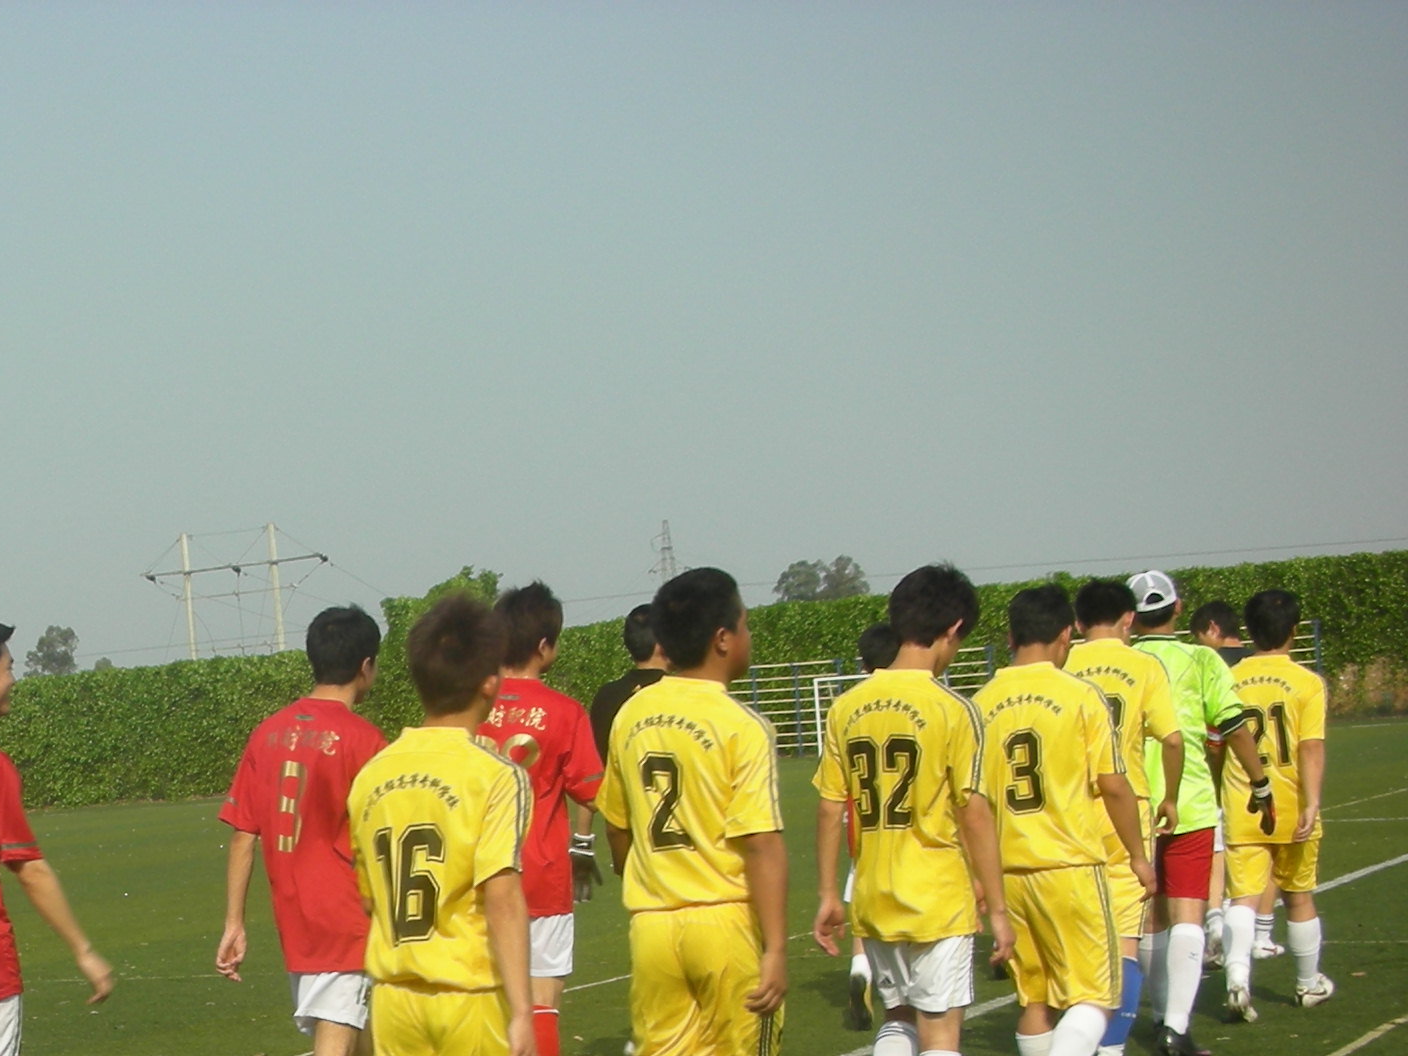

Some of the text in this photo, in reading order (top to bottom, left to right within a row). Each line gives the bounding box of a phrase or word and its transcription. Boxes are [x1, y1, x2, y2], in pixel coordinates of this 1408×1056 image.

[638, 752, 697, 852] 2
[846, 734, 922, 831] 32
[1003, 727, 1046, 815] 3
[374, 823, 446, 947] 16
